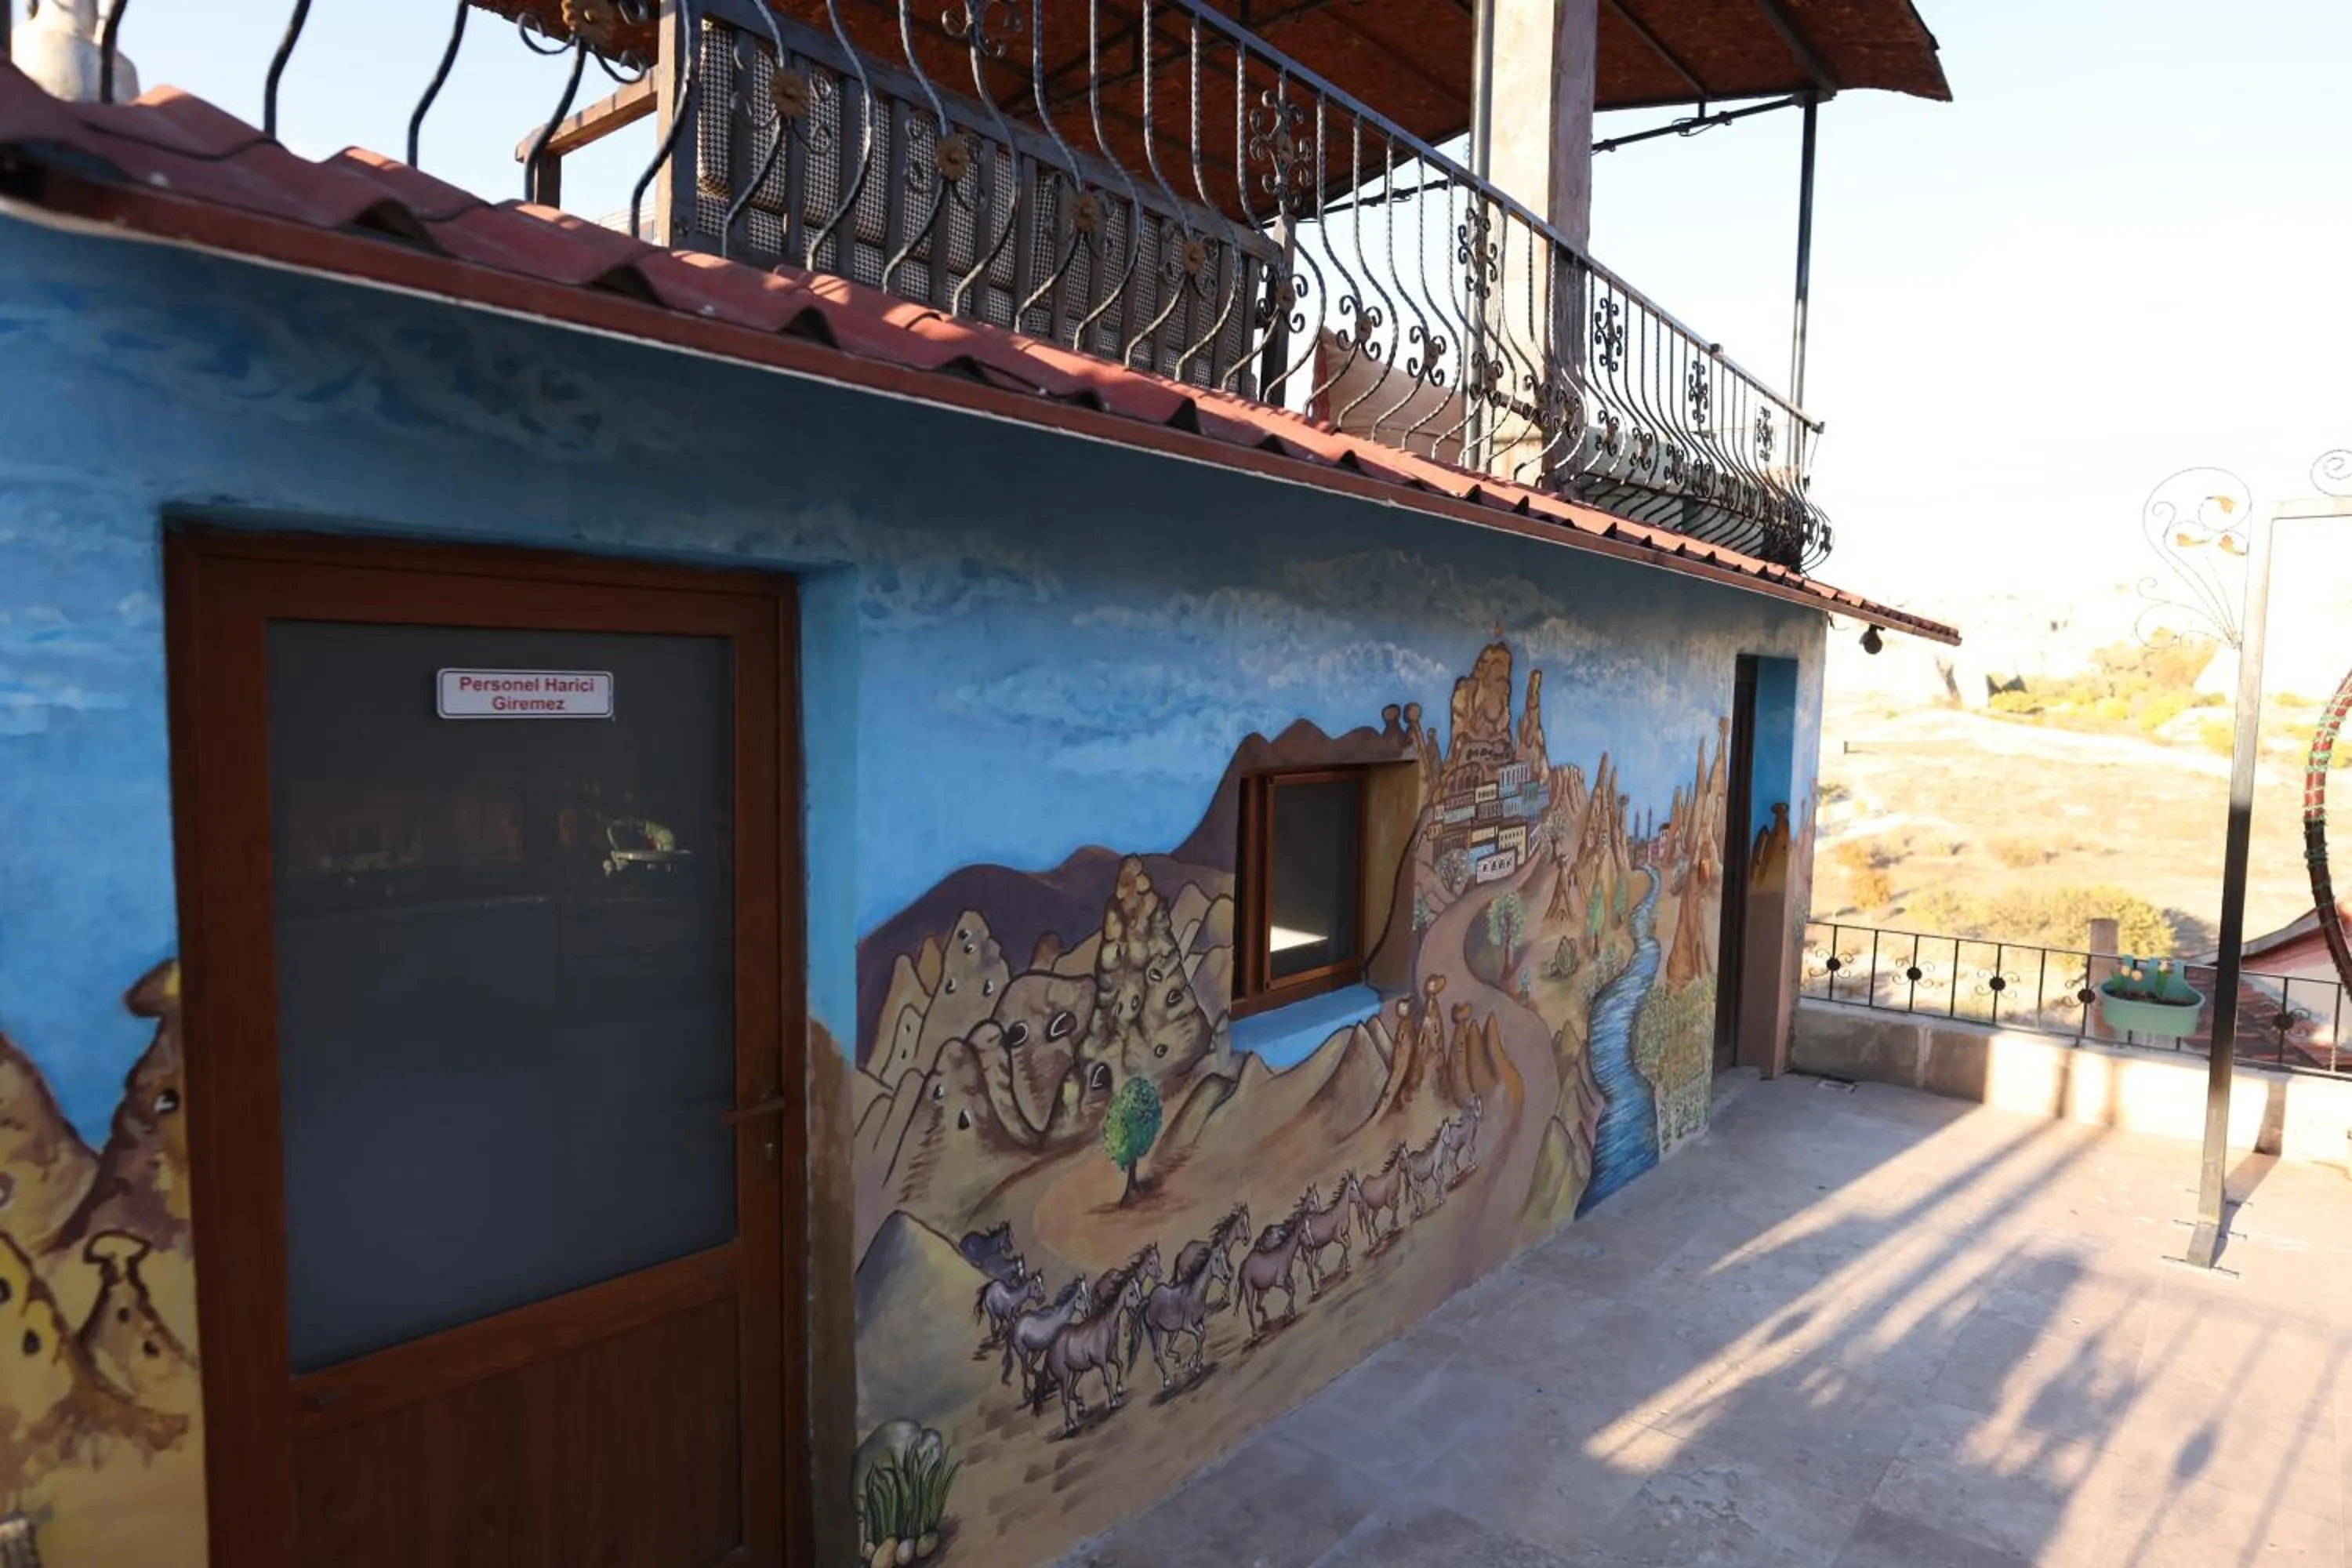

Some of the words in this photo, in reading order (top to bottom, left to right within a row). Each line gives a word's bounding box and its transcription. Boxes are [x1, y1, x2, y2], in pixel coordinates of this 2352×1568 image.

[459, 677, 539, 692] Personel
[545, 677, 595, 693] Harici
[492, 695, 565, 711] Giremez
